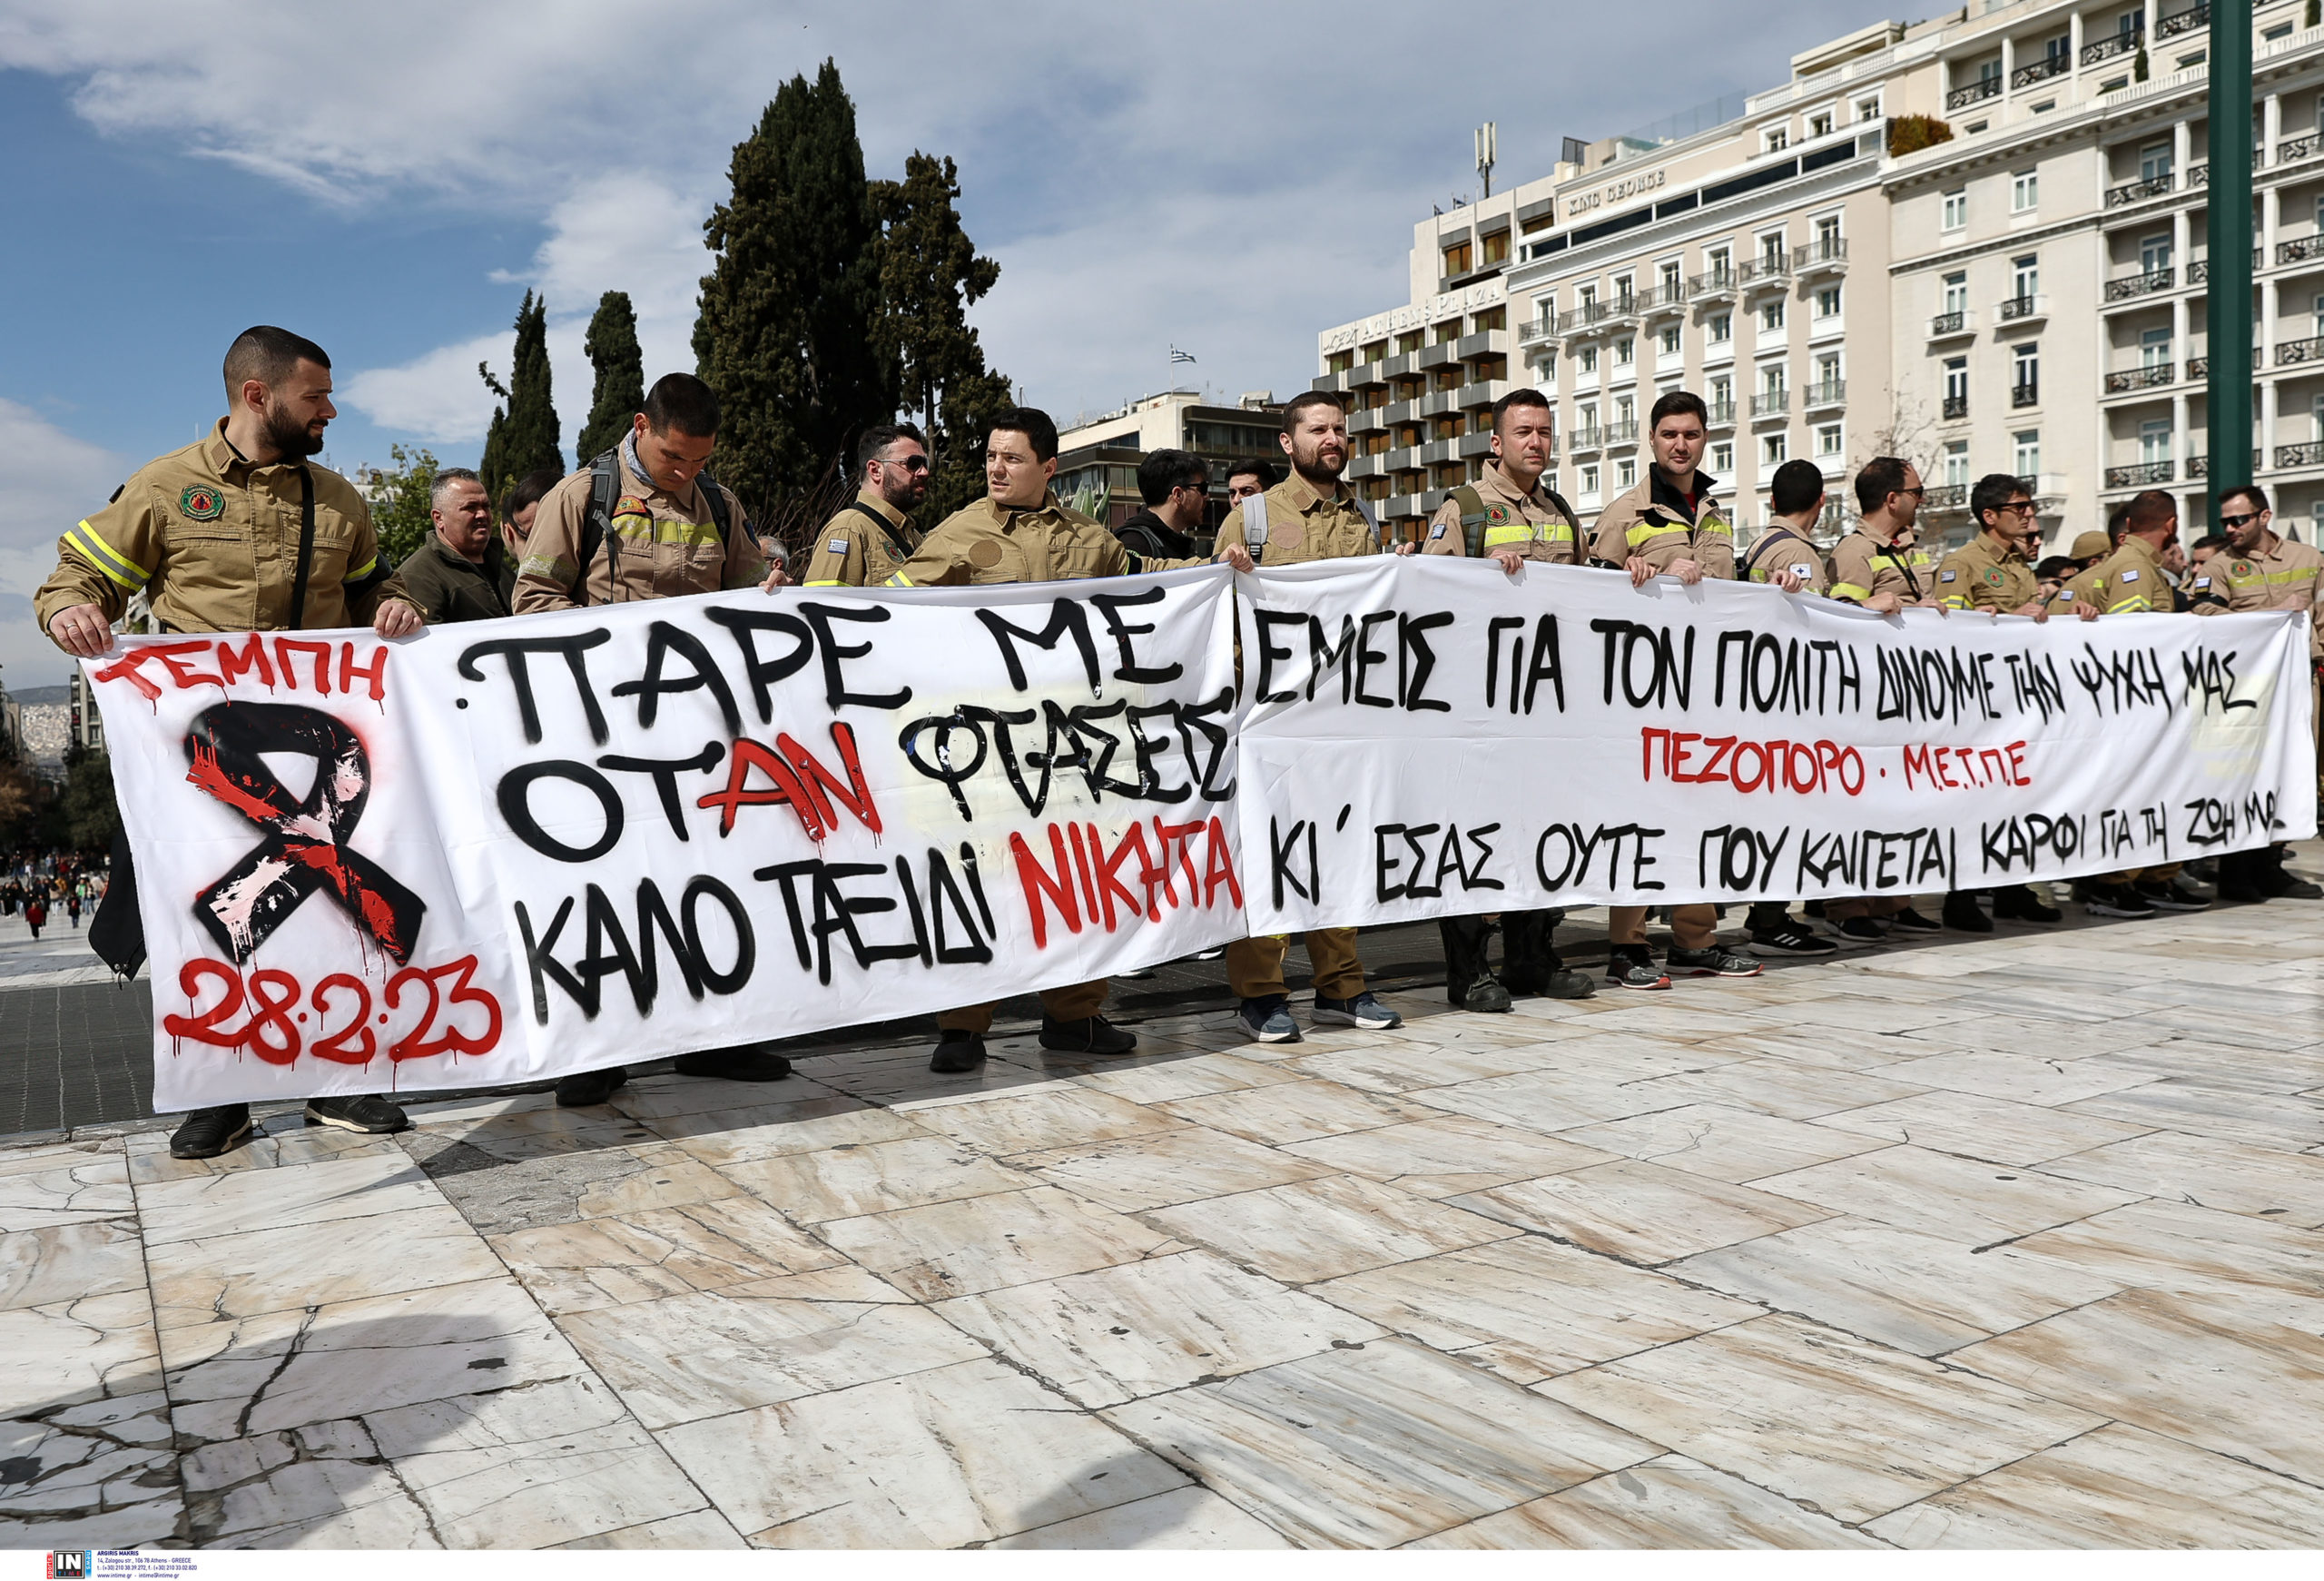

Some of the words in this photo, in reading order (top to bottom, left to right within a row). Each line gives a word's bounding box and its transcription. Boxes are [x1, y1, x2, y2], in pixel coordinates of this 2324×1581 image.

[1569, 192, 1601, 216] KING
[1606, 170, 1666, 203] GEORGE
[1362, 301, 1432, 341] ATHENS
[1435, 282, 1502, 319] PLAZA
[94, 632, 389, 705] ΤΕΜΠΗ
[975, 586, 1184, 697] ΜΕ
[1253, 608, 1455, 713] ΕΜΕΙΣ
[1486, 613, 1565, 715] ΓΙΑ
[1590, 618, 1695, 712] ΤΟΝ
[1714, 630, 1860, 716] ΠΟΛΙΤΗ
[1876, 644, 2002, 726] ΔΙΝΟΥΜΕ
[2004, 648, 2066, 725] ΤΗΝ
[2071, 642, 2172, 718] ΨΥΧΗ
[2181, 645, 2258, 716] ΜΑΣ
[496, 722, 883, 864] ΟΤΑΝ
[1641, 726, 1866, 796] ΠΕΖΟΠΟΡΟ
[1374, 822, 1505, 904] ΕΣΑΣ
[1535, 822, 1666, 893] ΟΥΤΕ
[1699, 823, 1789, 894] ΠΟΥ
[1797, 825, 1956, 894] ΚΑΙΓΕΤΑΙ
[1981, 812, 2087, 873] ΚΑΡΦΙ
[2100, 808, 2134, 858] ΓΙΑ
[2139, 801, 2169, 860] ΤΗ
[513, 874, 756, 1026] ΚΑΛΟ
[1008, 815, 1243, 950] ΝΙΚΗΤΑ
